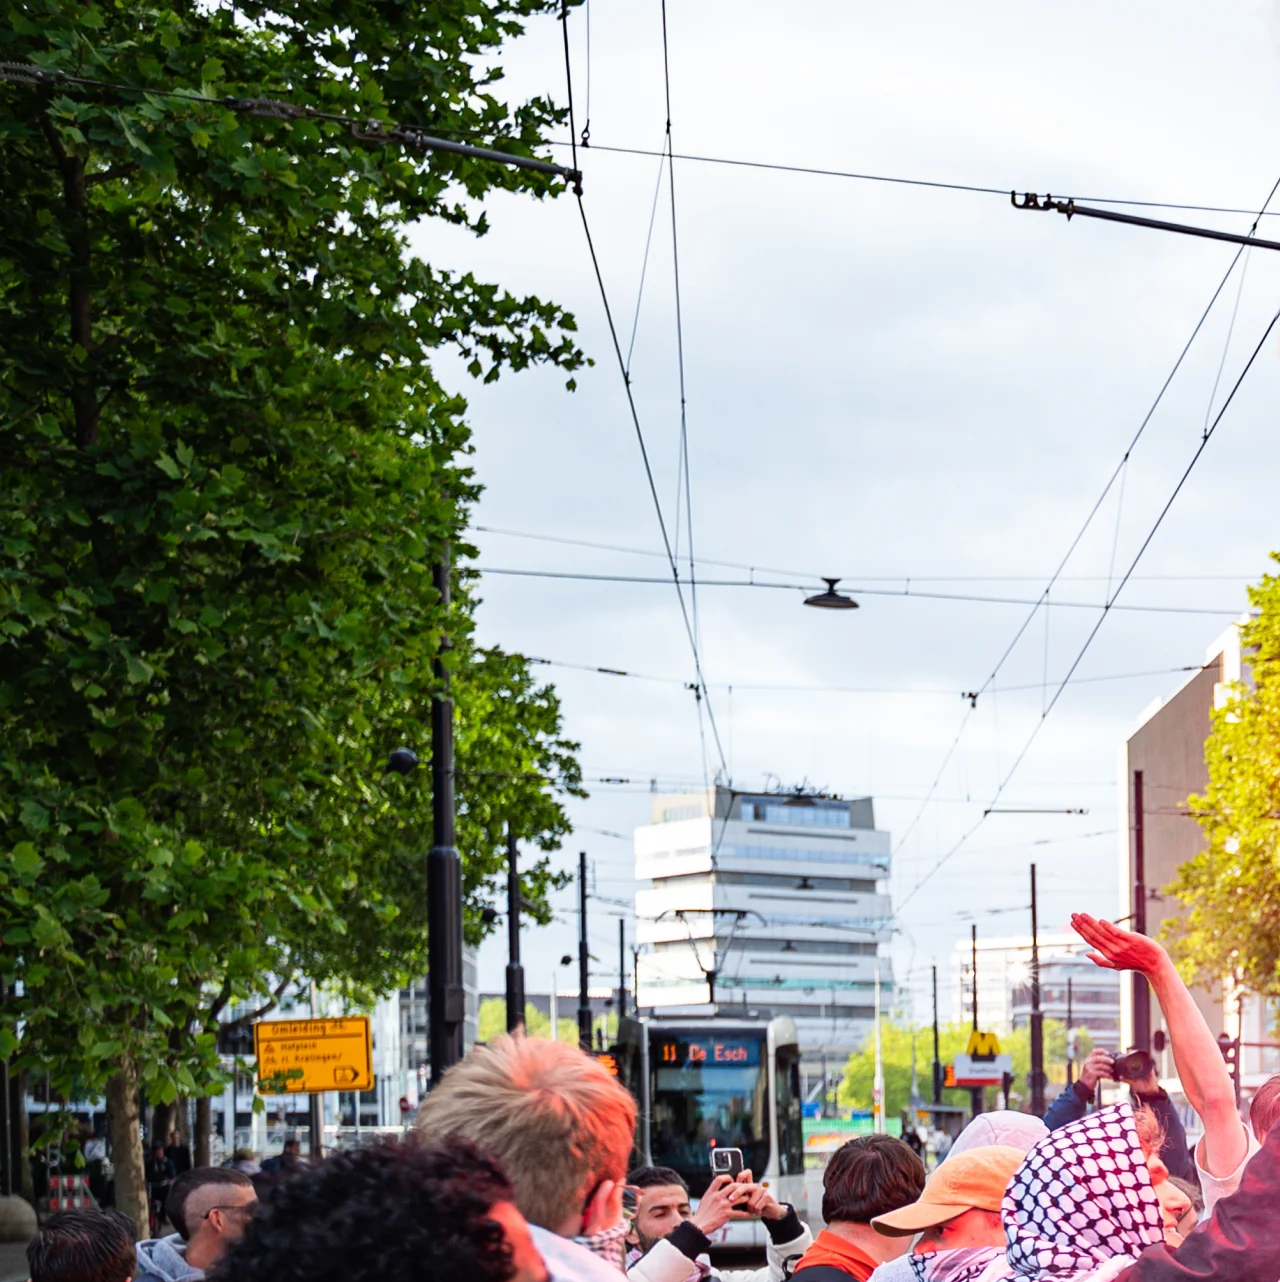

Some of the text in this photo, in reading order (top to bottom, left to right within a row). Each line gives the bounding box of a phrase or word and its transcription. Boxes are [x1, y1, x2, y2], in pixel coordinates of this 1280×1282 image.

[271, 1020, 327, 1037] Omleiding
[663, 1044, 748, 1061] 11 De Esch
